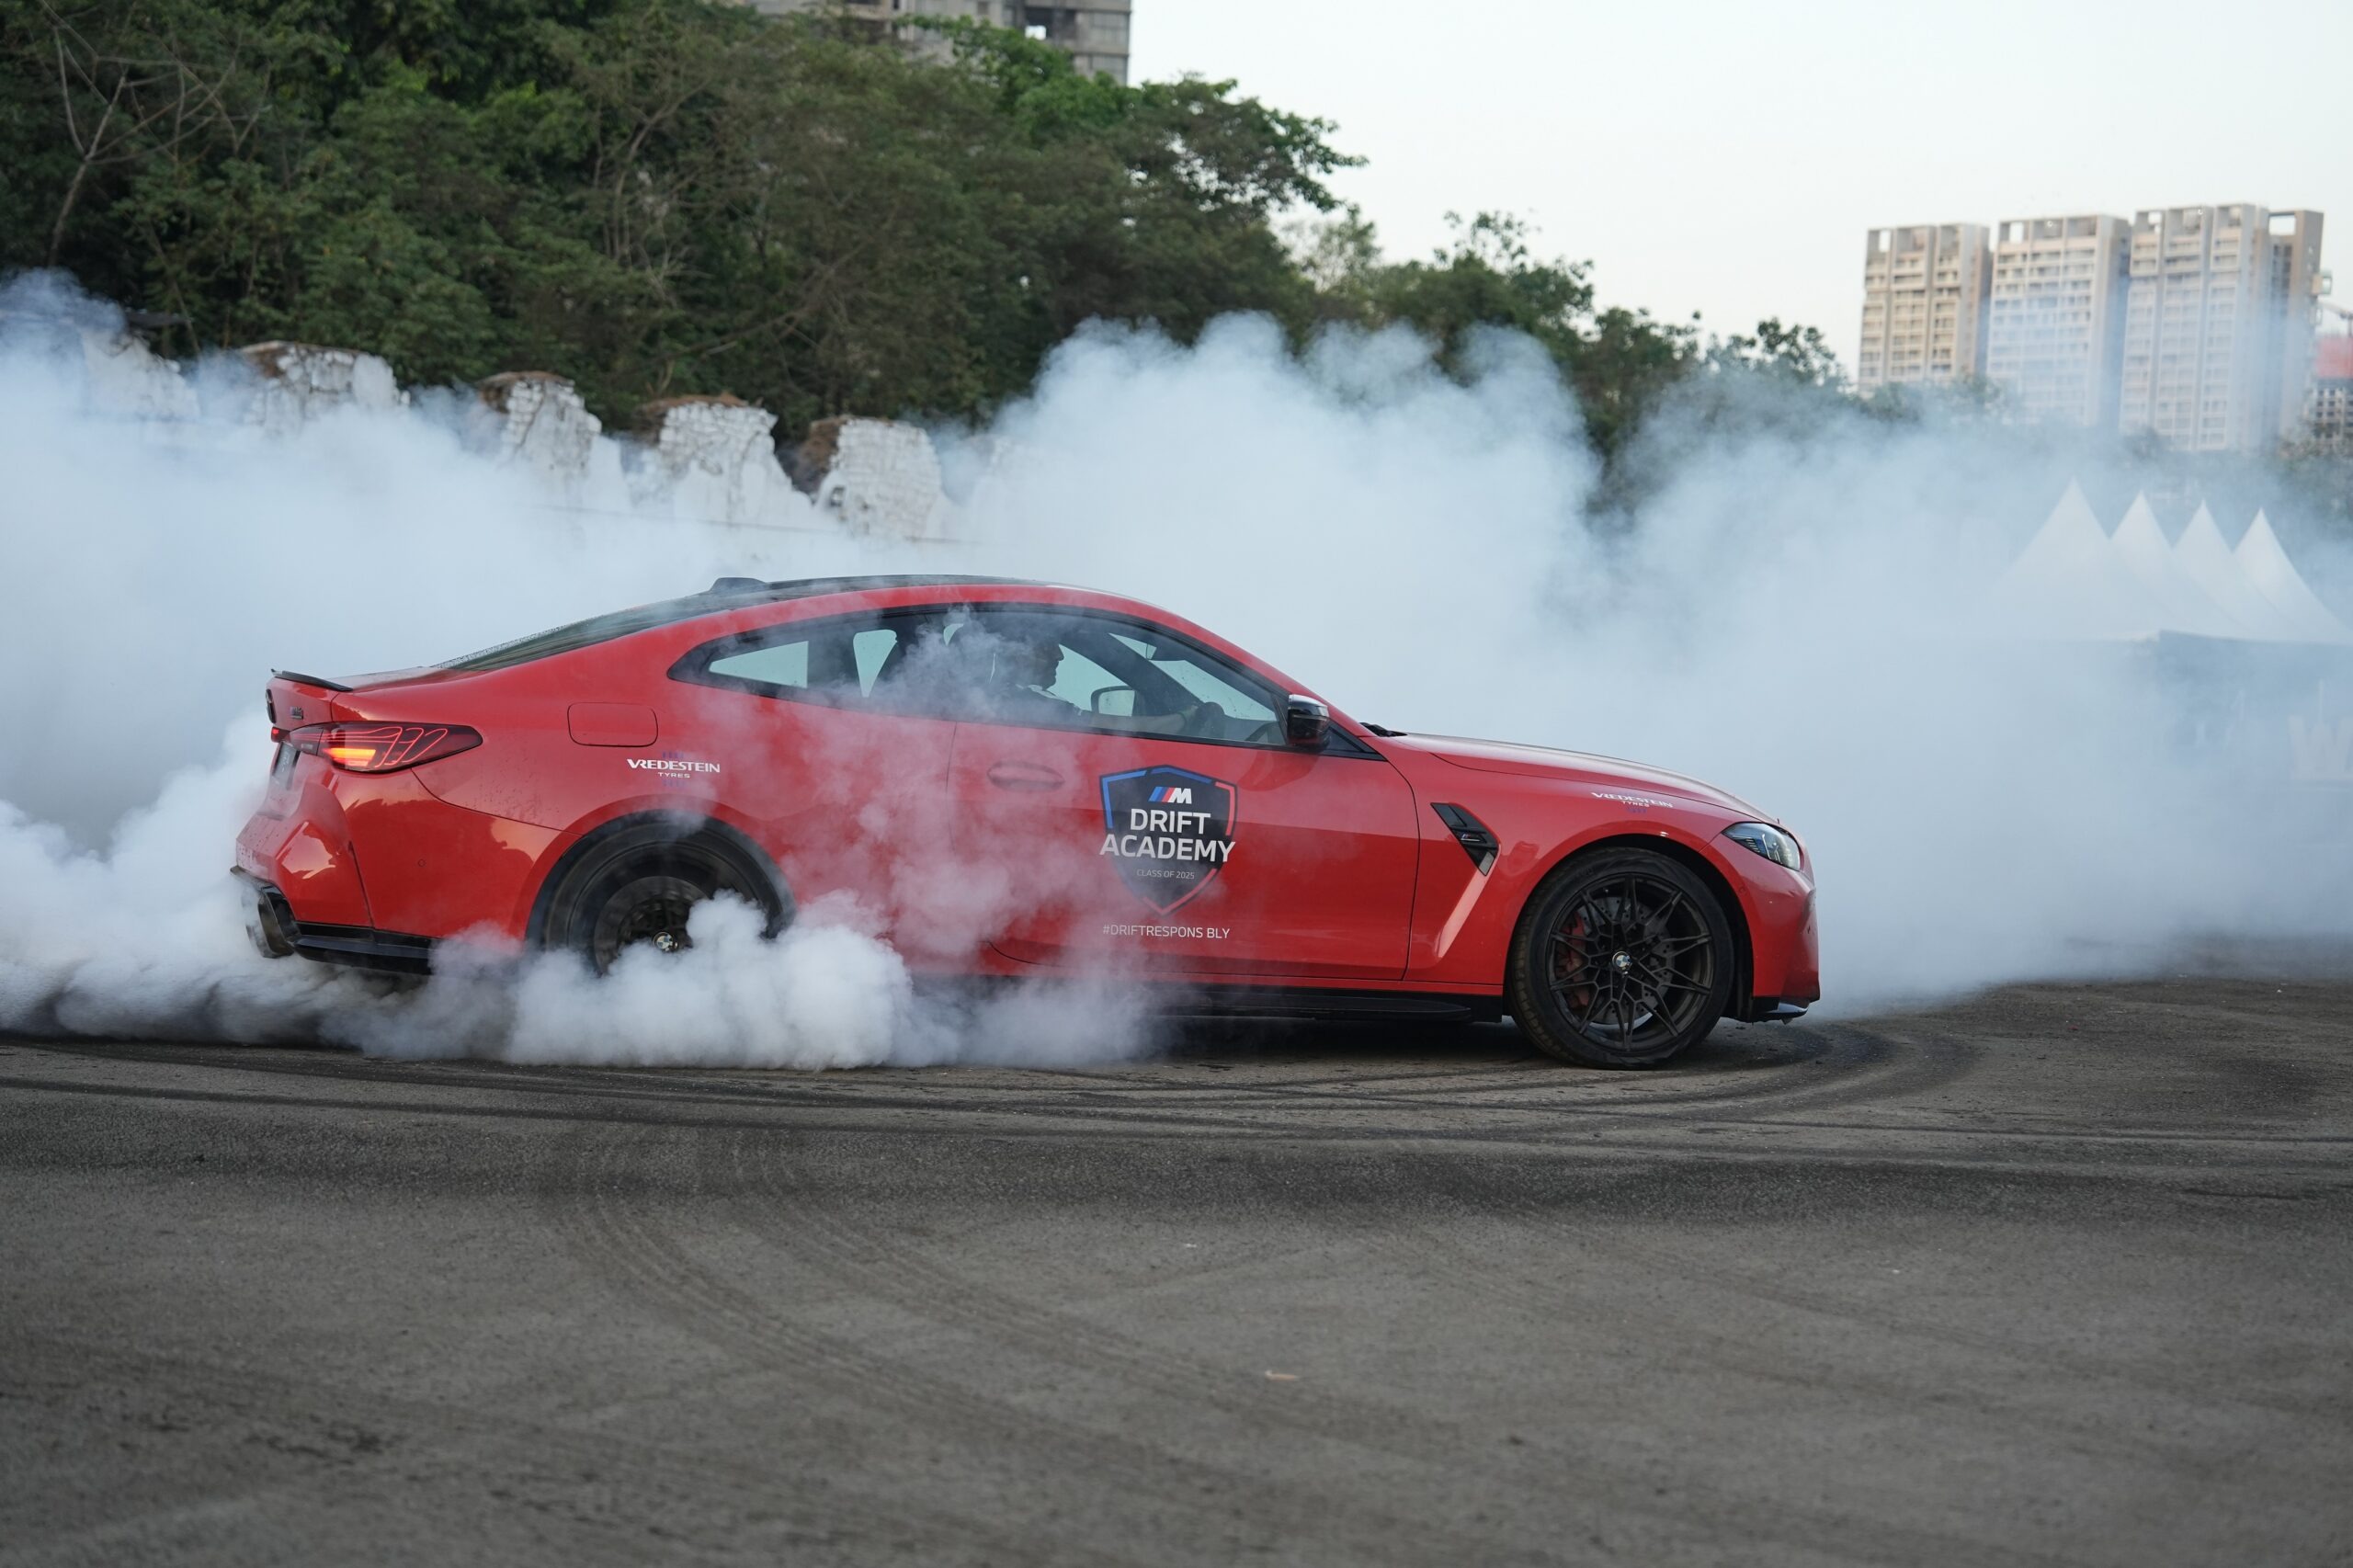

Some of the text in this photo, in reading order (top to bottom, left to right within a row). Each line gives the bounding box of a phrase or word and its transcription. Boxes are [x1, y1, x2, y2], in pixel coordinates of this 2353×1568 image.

[627, 758, 720, 772] VREDESTEIN
[1130, 808, 1211, 835] DRIFT
[1099, 834, 1236, 863] ACADEMY
[1136, 869, 1195, 880] CLASS OF 2025
